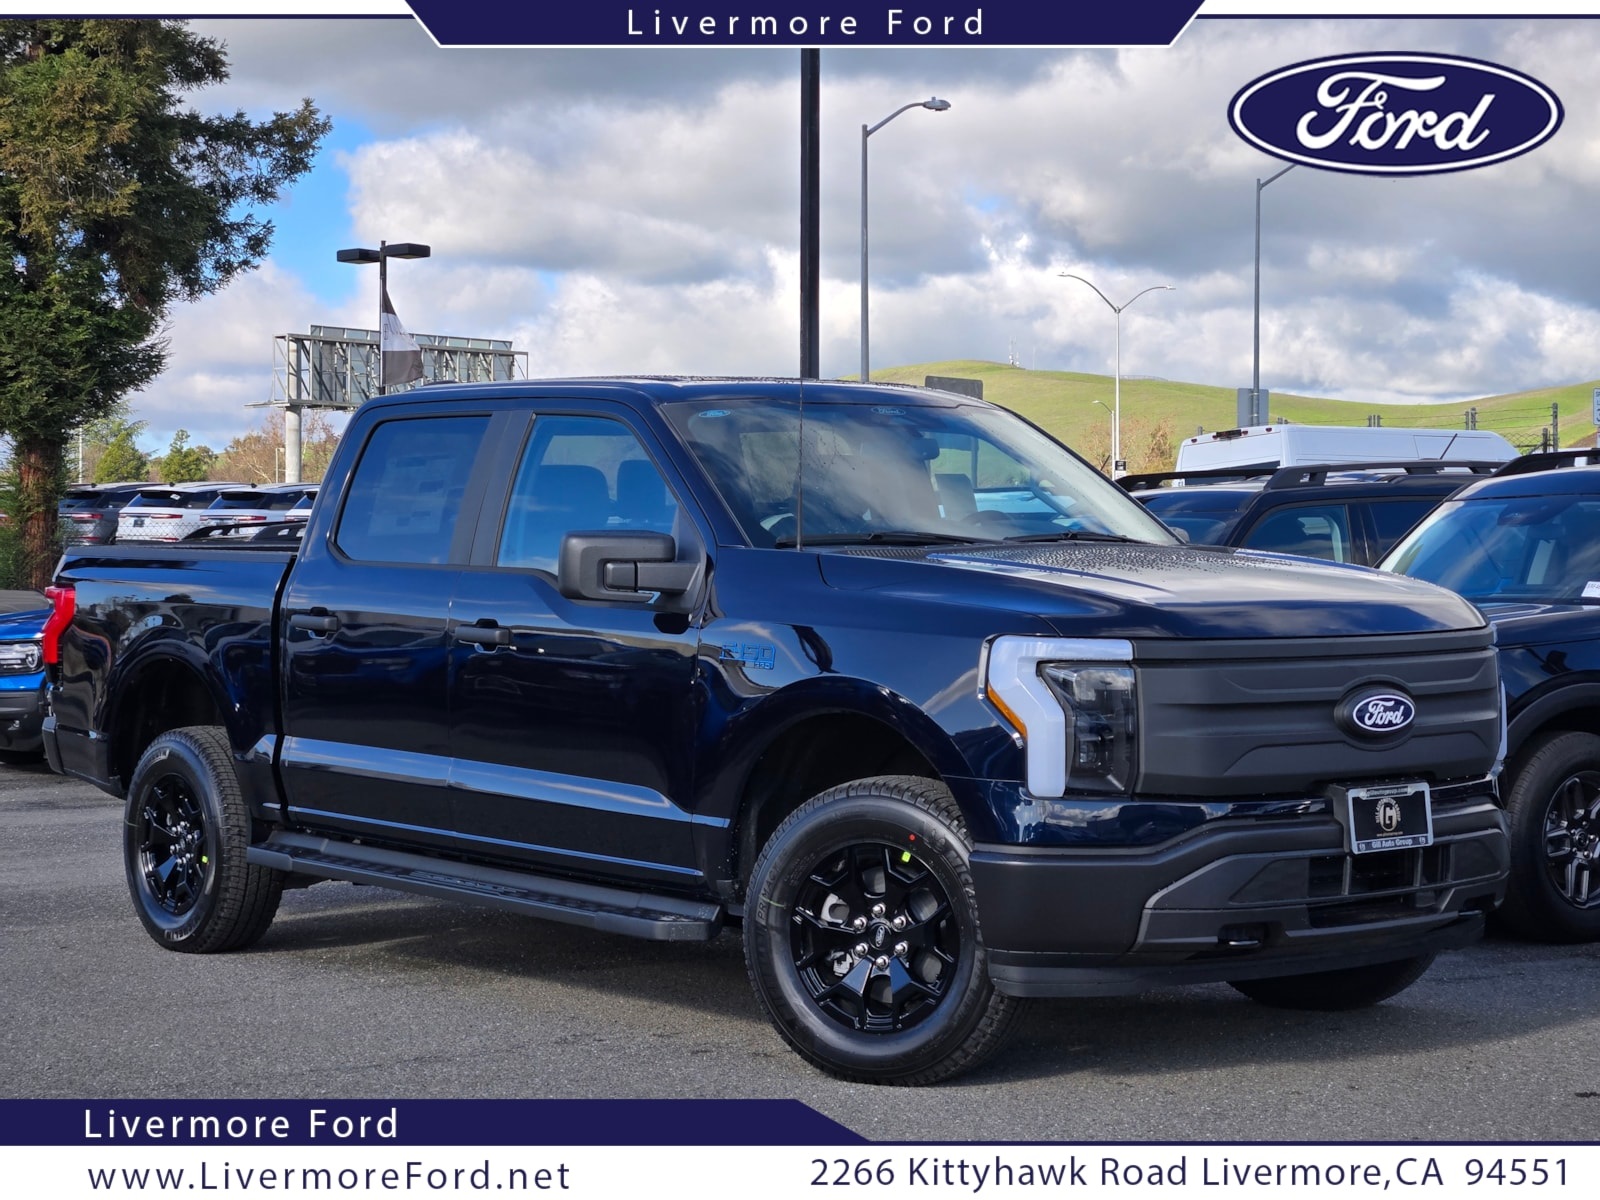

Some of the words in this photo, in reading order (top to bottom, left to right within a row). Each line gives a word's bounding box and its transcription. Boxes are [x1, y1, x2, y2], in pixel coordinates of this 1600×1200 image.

[1364, 700, 1405, 726] Ford
[1395, 838, 1412, 846] Group
[757, 861, 781, 919] PRMACY
